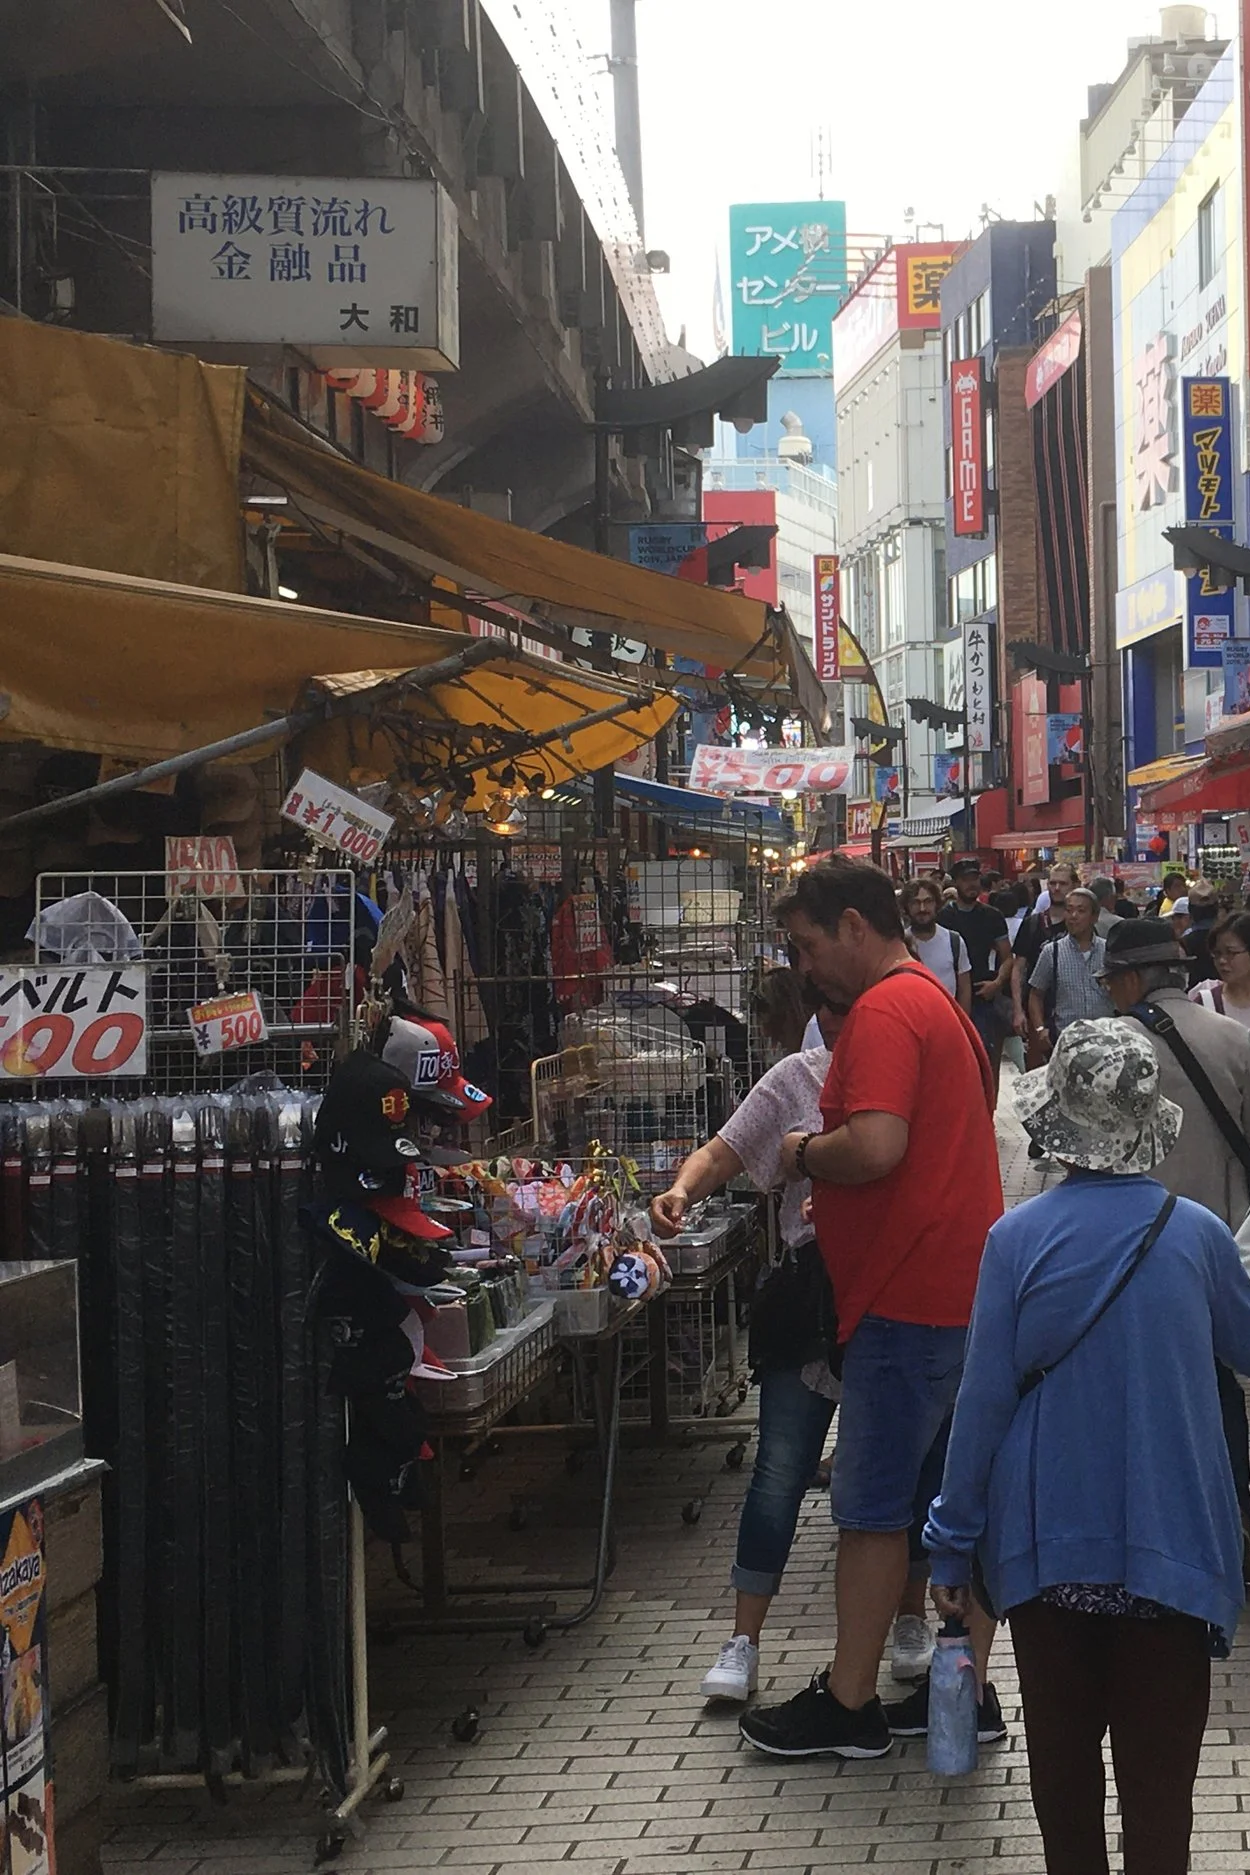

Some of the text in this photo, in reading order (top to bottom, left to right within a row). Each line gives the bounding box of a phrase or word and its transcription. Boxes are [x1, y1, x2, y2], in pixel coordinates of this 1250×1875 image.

[177, 193, 396, 238] 高級質流れ
[744, 223, 830, 257] アメ横
[210, 243, 368, 284] 金融品
[736, 275, 842, 309] センター
[339, 303, 420, 334] 大和
[761, 322, 818, 353] ビル
[1192, 386, 1221, 414] 薬
[959, 398, 976, 522] GAME
[637, 536, 672, 544] RUGBY
[819, 594, 836, 678] サンドラッグ
[694, 762, 849, 791] ¥500
[0, 1012, 144, 1077] 00
[421, 1055, 439, 1079] TO
